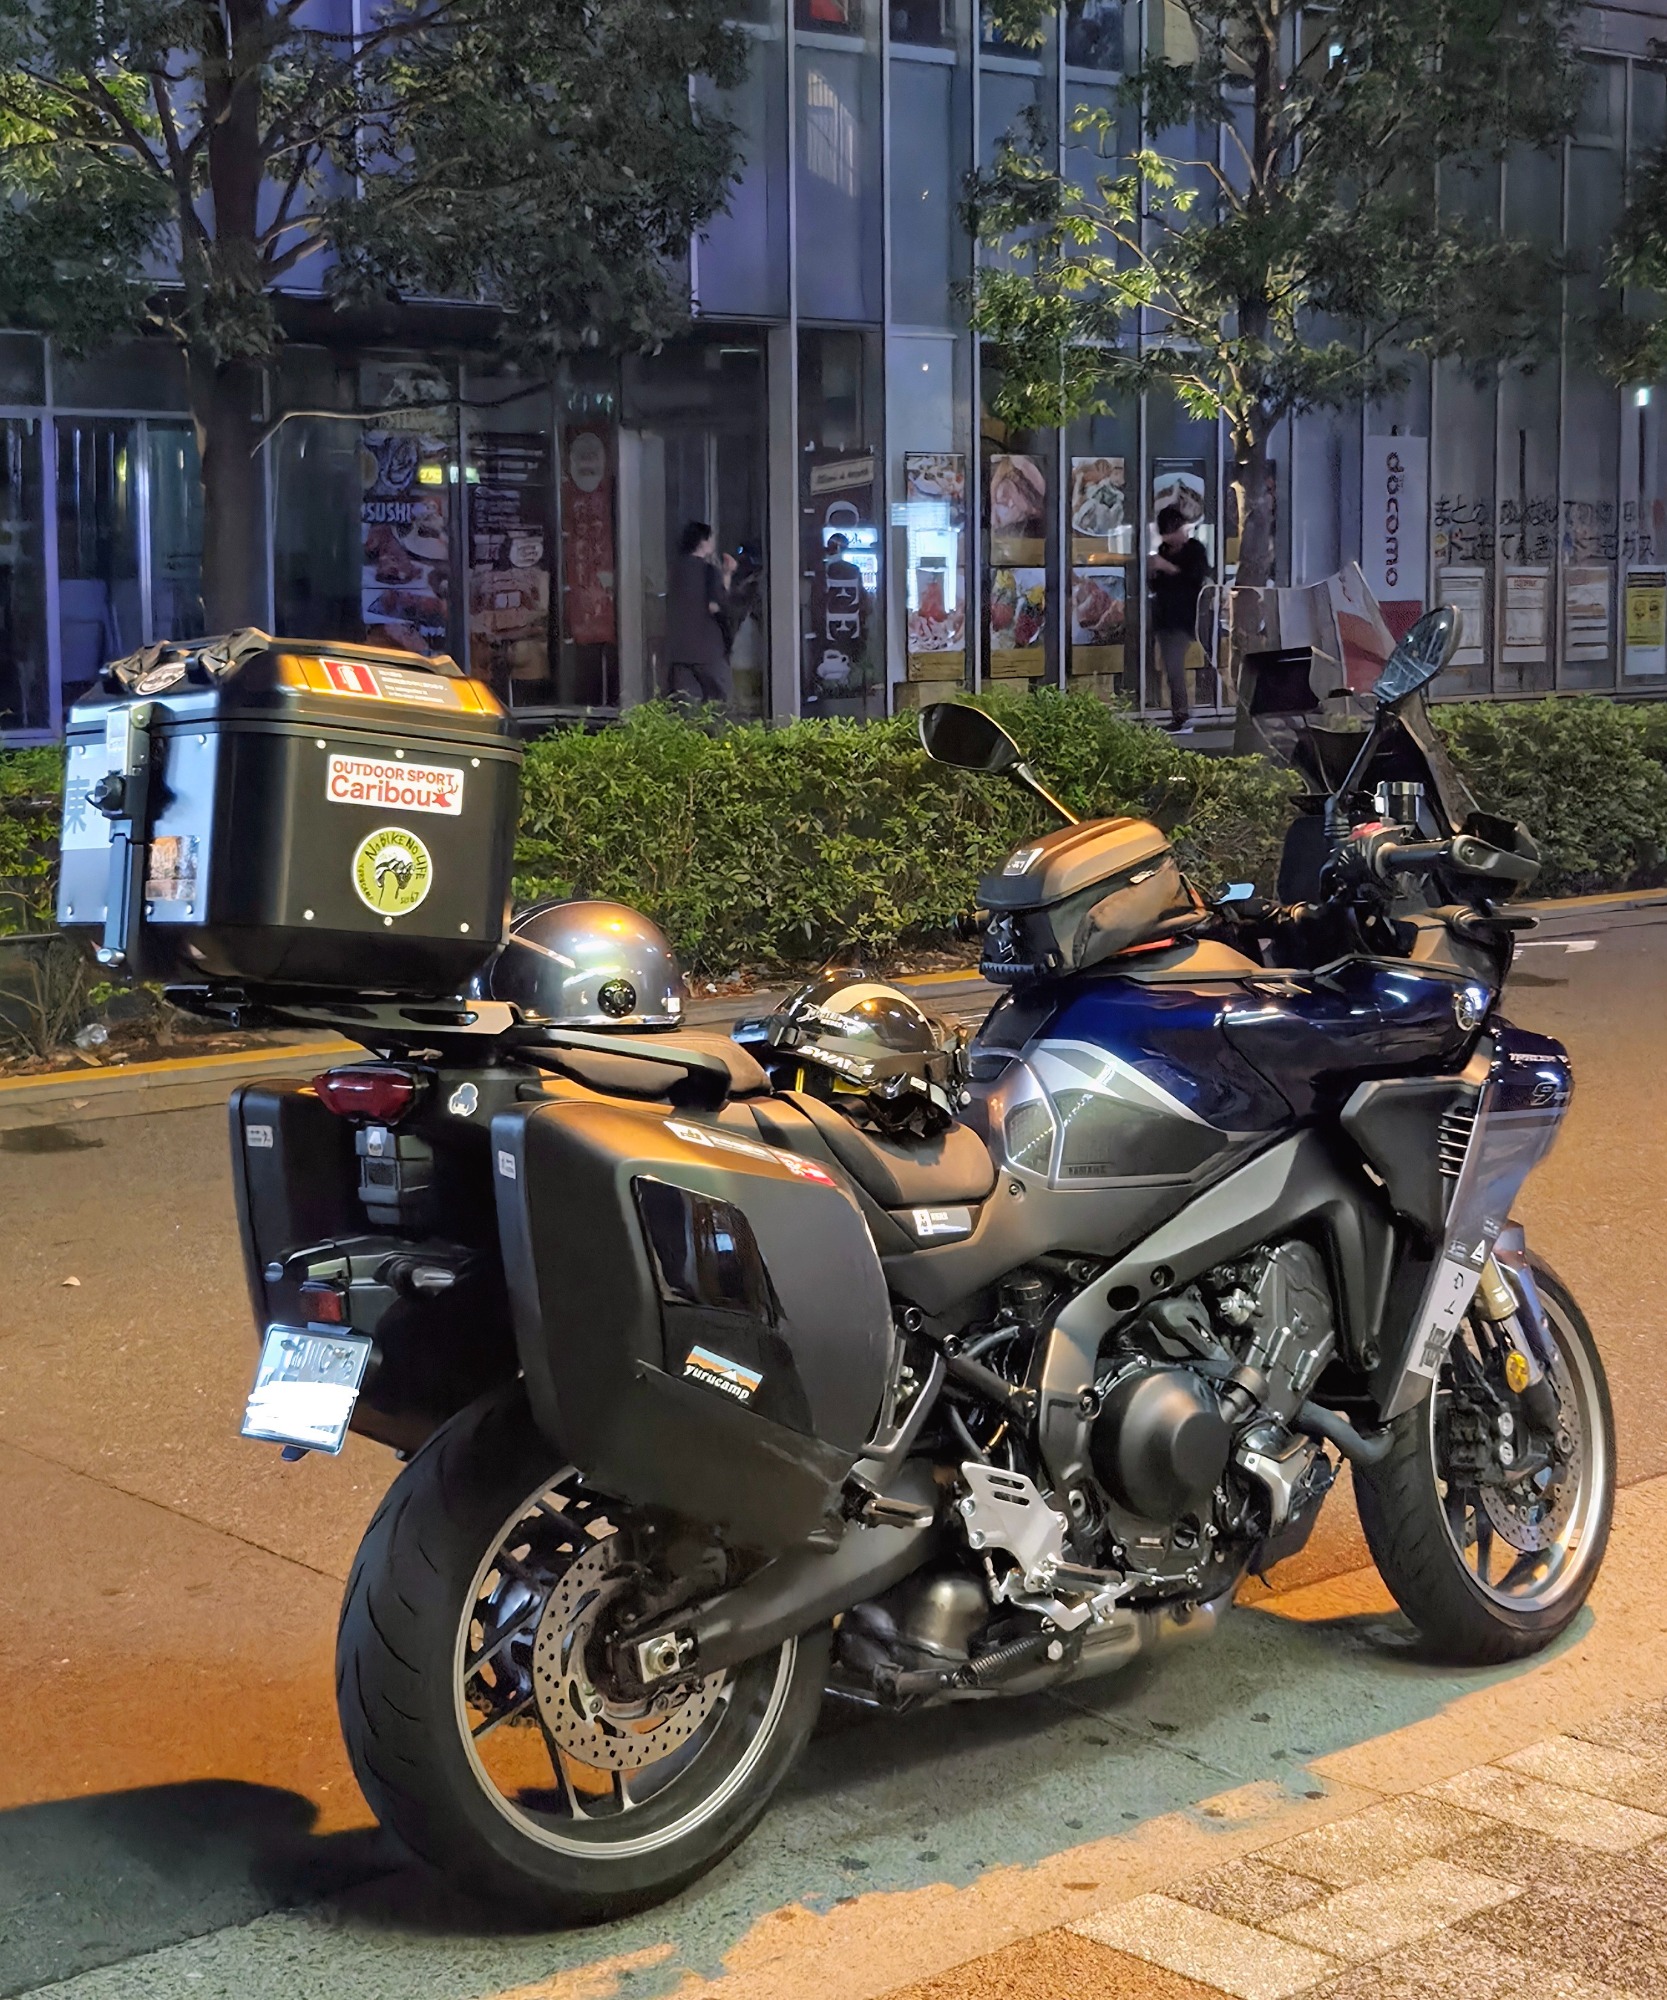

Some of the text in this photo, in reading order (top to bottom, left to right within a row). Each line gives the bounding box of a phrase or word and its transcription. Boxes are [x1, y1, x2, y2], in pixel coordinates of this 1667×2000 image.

[1386, 452, 1404, 587] docomo
[825, 500, 860, 641] CFE
[331, 774, 431, 807] Caribou
[333, 760, 455, 786] OUTDOOR SPORT
[379, 832, 406, 847] BIKE
[415, 855, 427, 880] LIFE
[683, 1365, 750, 1399] yurucamp
